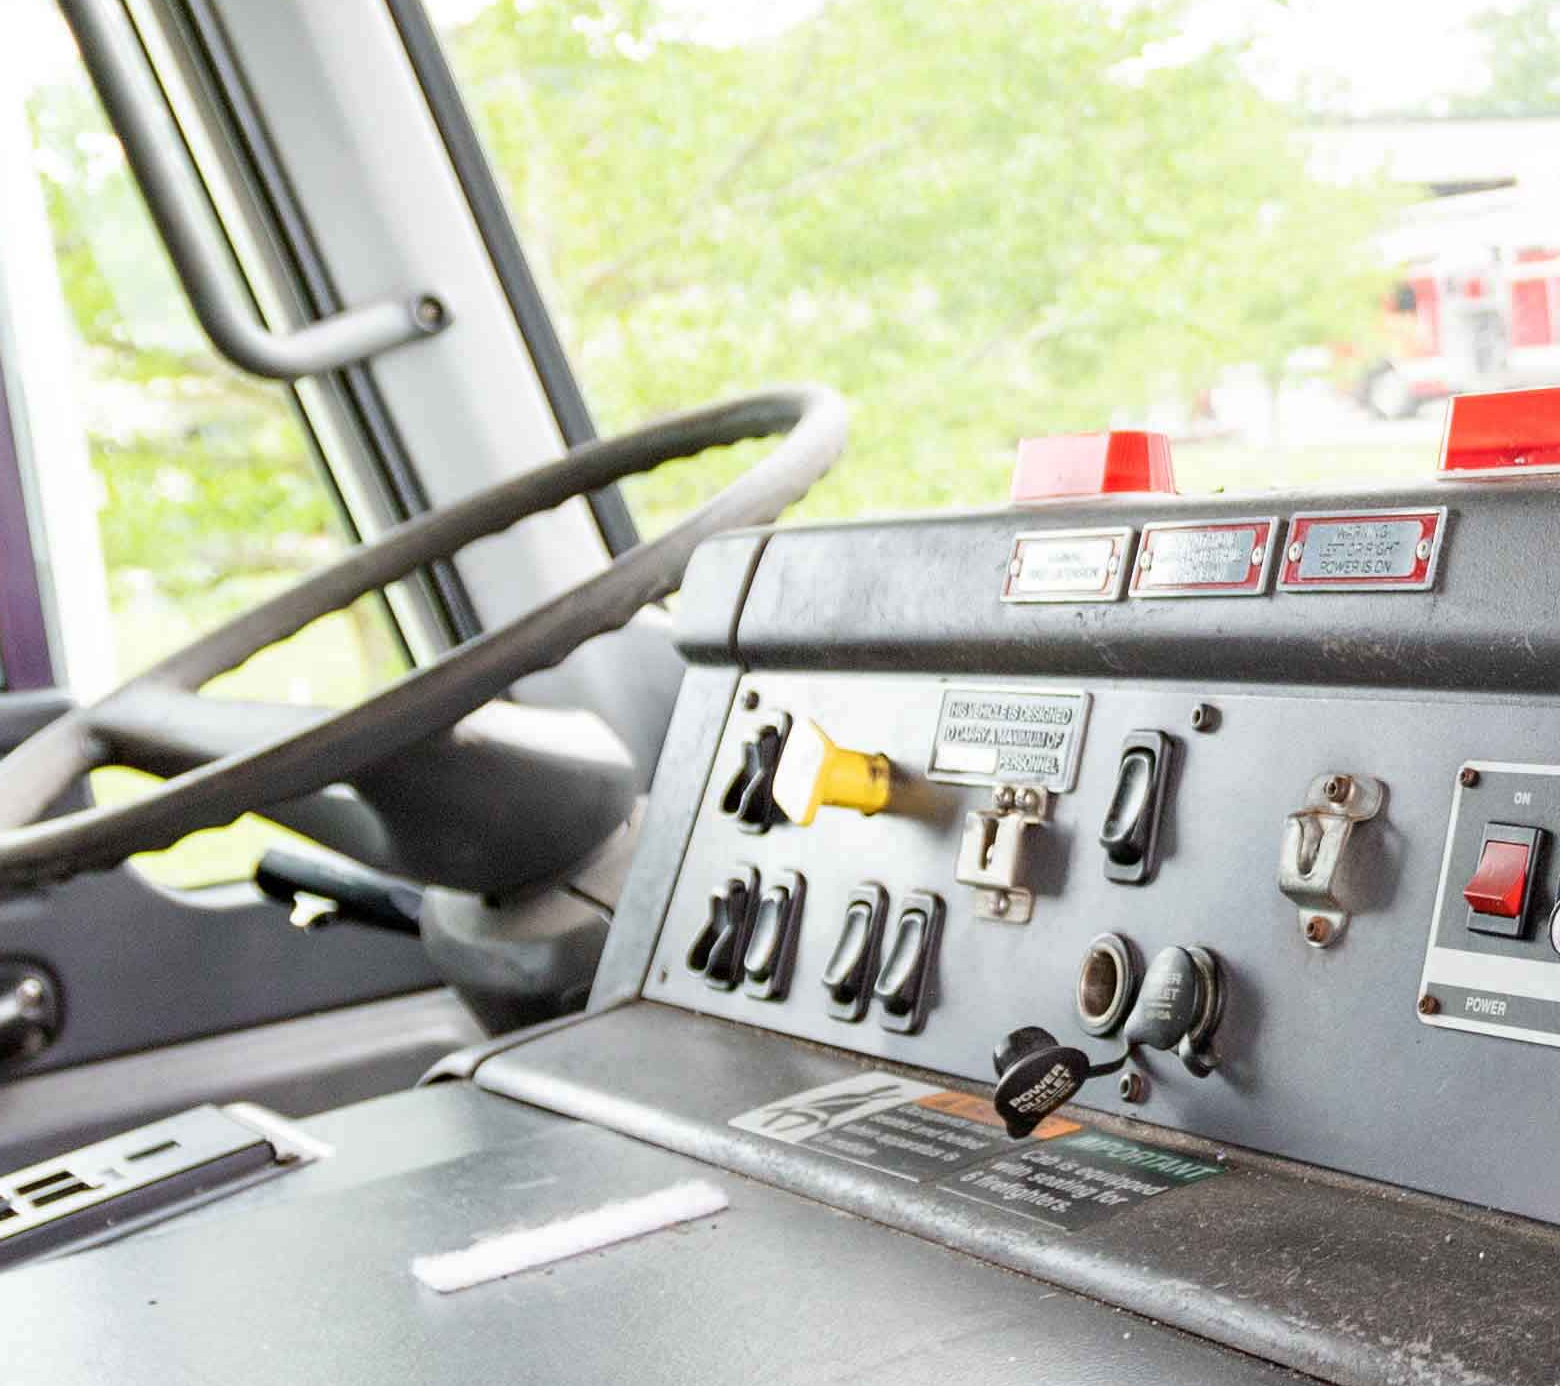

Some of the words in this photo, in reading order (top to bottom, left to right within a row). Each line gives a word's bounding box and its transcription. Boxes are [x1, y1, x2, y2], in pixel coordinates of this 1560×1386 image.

[1319, 560, 1359, 574] POWER
[1360, 560, 1371, 574] IS
[1374, 559, 1393, 573] ON
[1021, 705, 1073, 725] DESIGNED
[1047, 732, 1065, 749] OF
[999, 755, 1060, 775] PERSONNEL
[1513, 792, 1532, 806] ON
[1465, 996, 1507, 1017] POWER
[1009, 1063, 1065, 1108] POWER
[1017, 1069, 1073, 1114] OUTLET
[1067, 1134, 1218, 1180] IMPORTANT
[1021, 1150, 1061, 1165] Cab
[1074, 1167, 1169, 1196] equipped
[1028, 1171, 1100, 1200] seating
[1092, 1190, 1130, 1206] for
